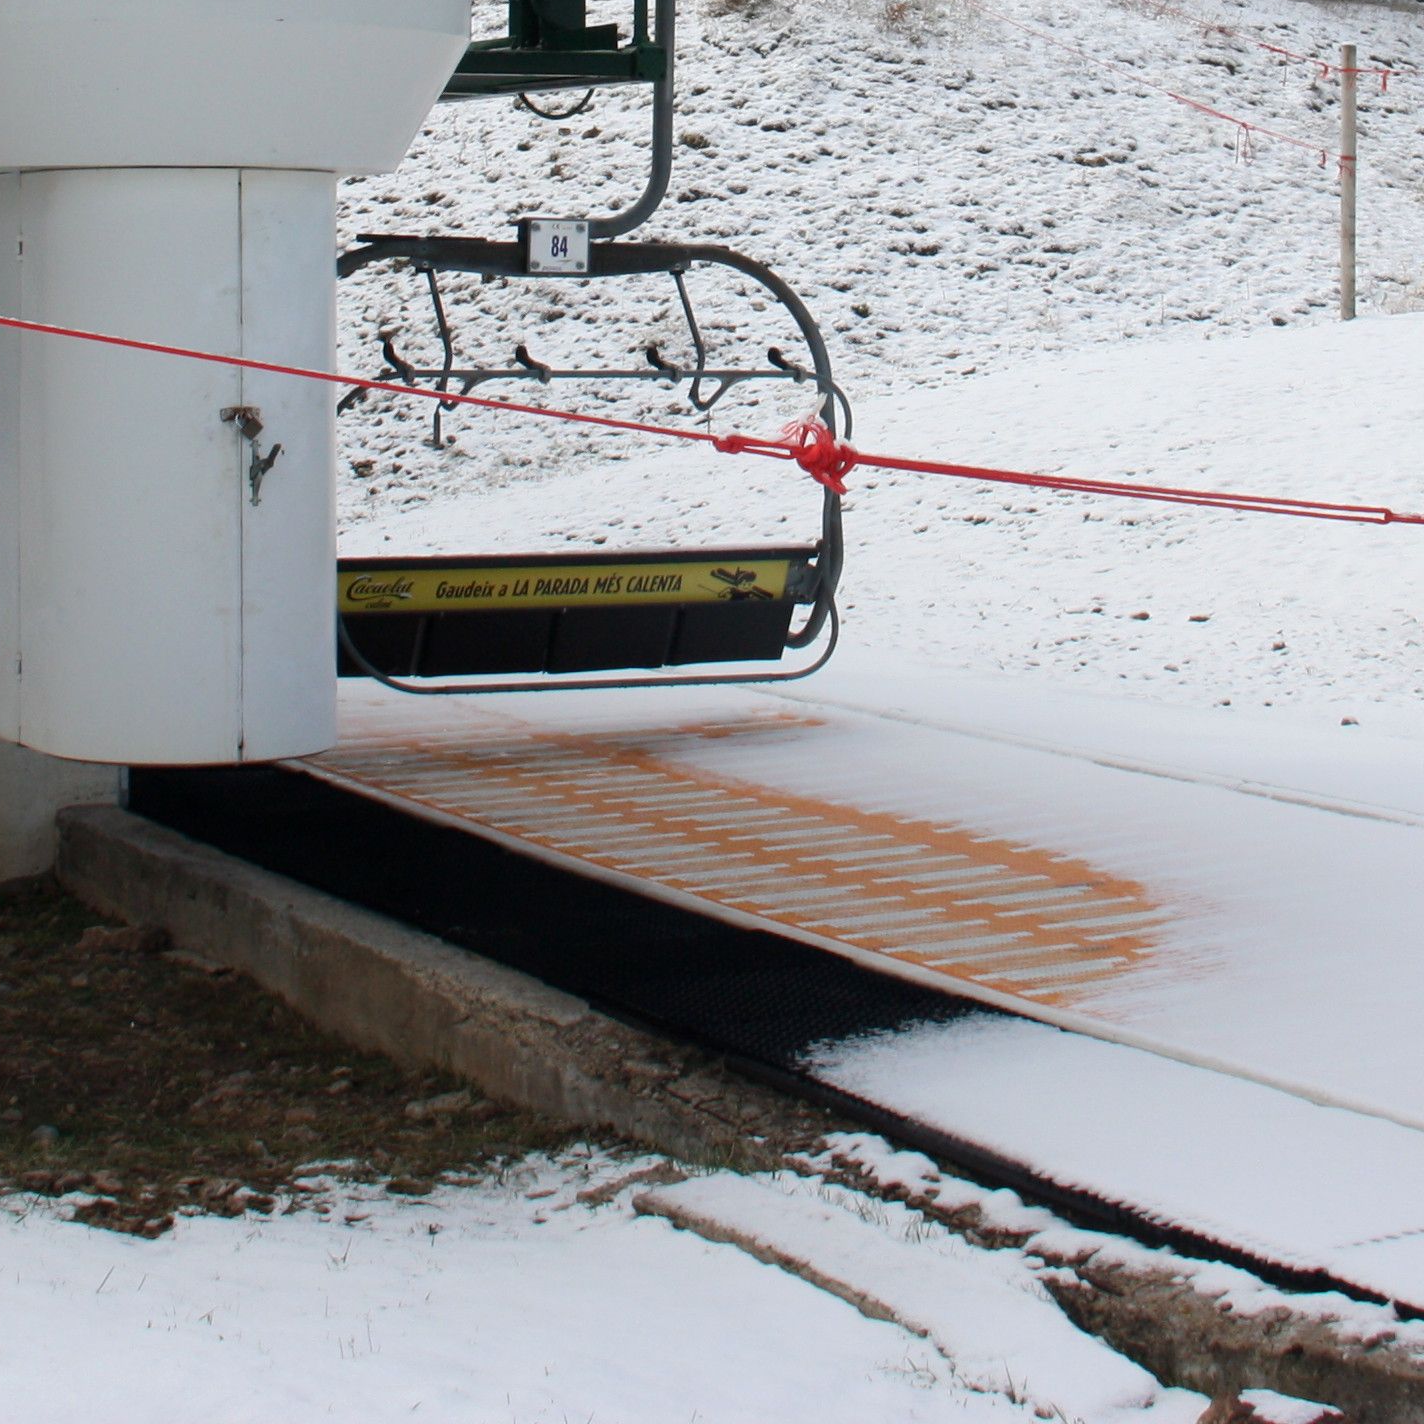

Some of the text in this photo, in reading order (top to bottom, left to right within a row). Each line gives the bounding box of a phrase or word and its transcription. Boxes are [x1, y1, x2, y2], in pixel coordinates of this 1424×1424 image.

[551, 235, 568, 257] 84
[436, 574, 683, 599] Gaudeix a LA PARADA MÉS CALENTA
